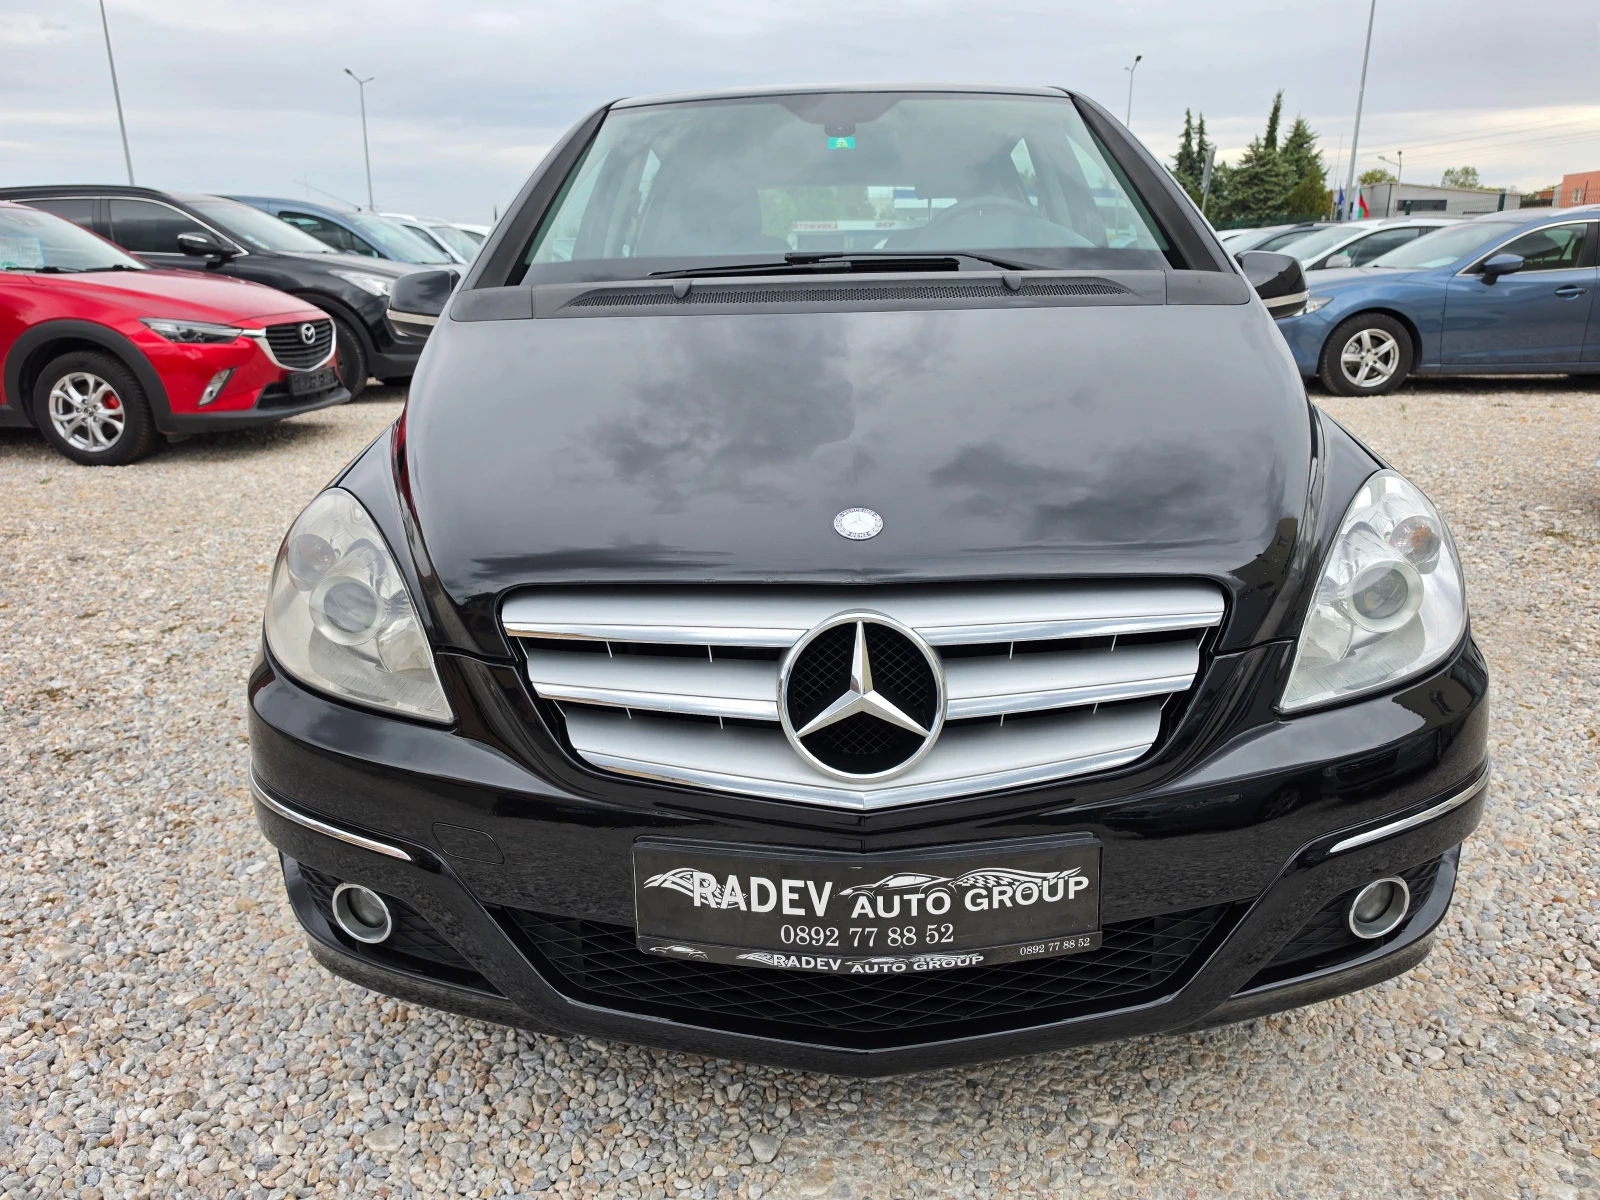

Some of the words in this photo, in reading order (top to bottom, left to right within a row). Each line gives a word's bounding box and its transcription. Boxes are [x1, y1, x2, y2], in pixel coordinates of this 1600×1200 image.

[692, 871, 833, 917] RADEV
[851, 891, 951, 919] AUTO
[964, 876, 1089, 912] GROUP
[780, 924, 840, 947] 0892
[849, 927, 878, 947] 77
[887, 925, 917, 947] 88
[925, 923, 954, 944] 52
[1020, 944, 1045, 956] 0892
[1048, 942, 1060, 952] 77
[1063, 940, 1075, 950] 88
[1078, 937, 1090, 947] 52
[773, 954, 841, 971] RADEV
[850, 963, 907, 974] AUTO
[913, 955, 985, 971] GROUP
